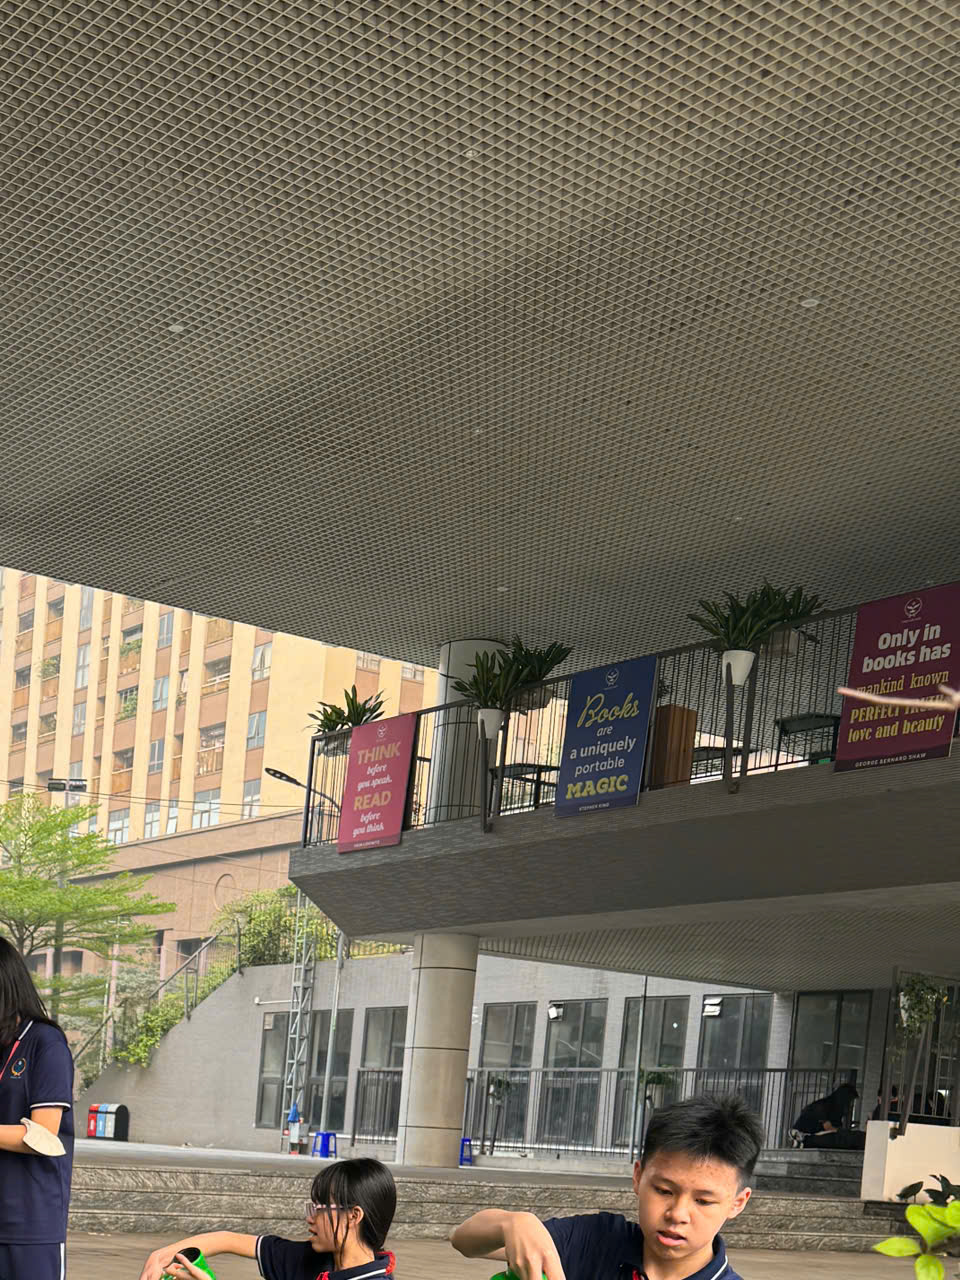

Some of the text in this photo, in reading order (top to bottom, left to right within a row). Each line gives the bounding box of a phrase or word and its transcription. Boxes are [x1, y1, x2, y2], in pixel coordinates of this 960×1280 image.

[877, 624, 941, 650] Only in
[862, 643, 951, 673] books has
[857, 671, 949, 696] mankind known
[576, 692, 640, 727] Books
[596, 726, 613, 737] are
[875, 721, 900, 739] and
[357, 741, 401, 764] THINK
[570, 736, 637, 760] a uniquely
[575, 756, 625, 777] portable
[565, 774, 629, 800] MAGIC
[353, 790, 392, 811] READ
